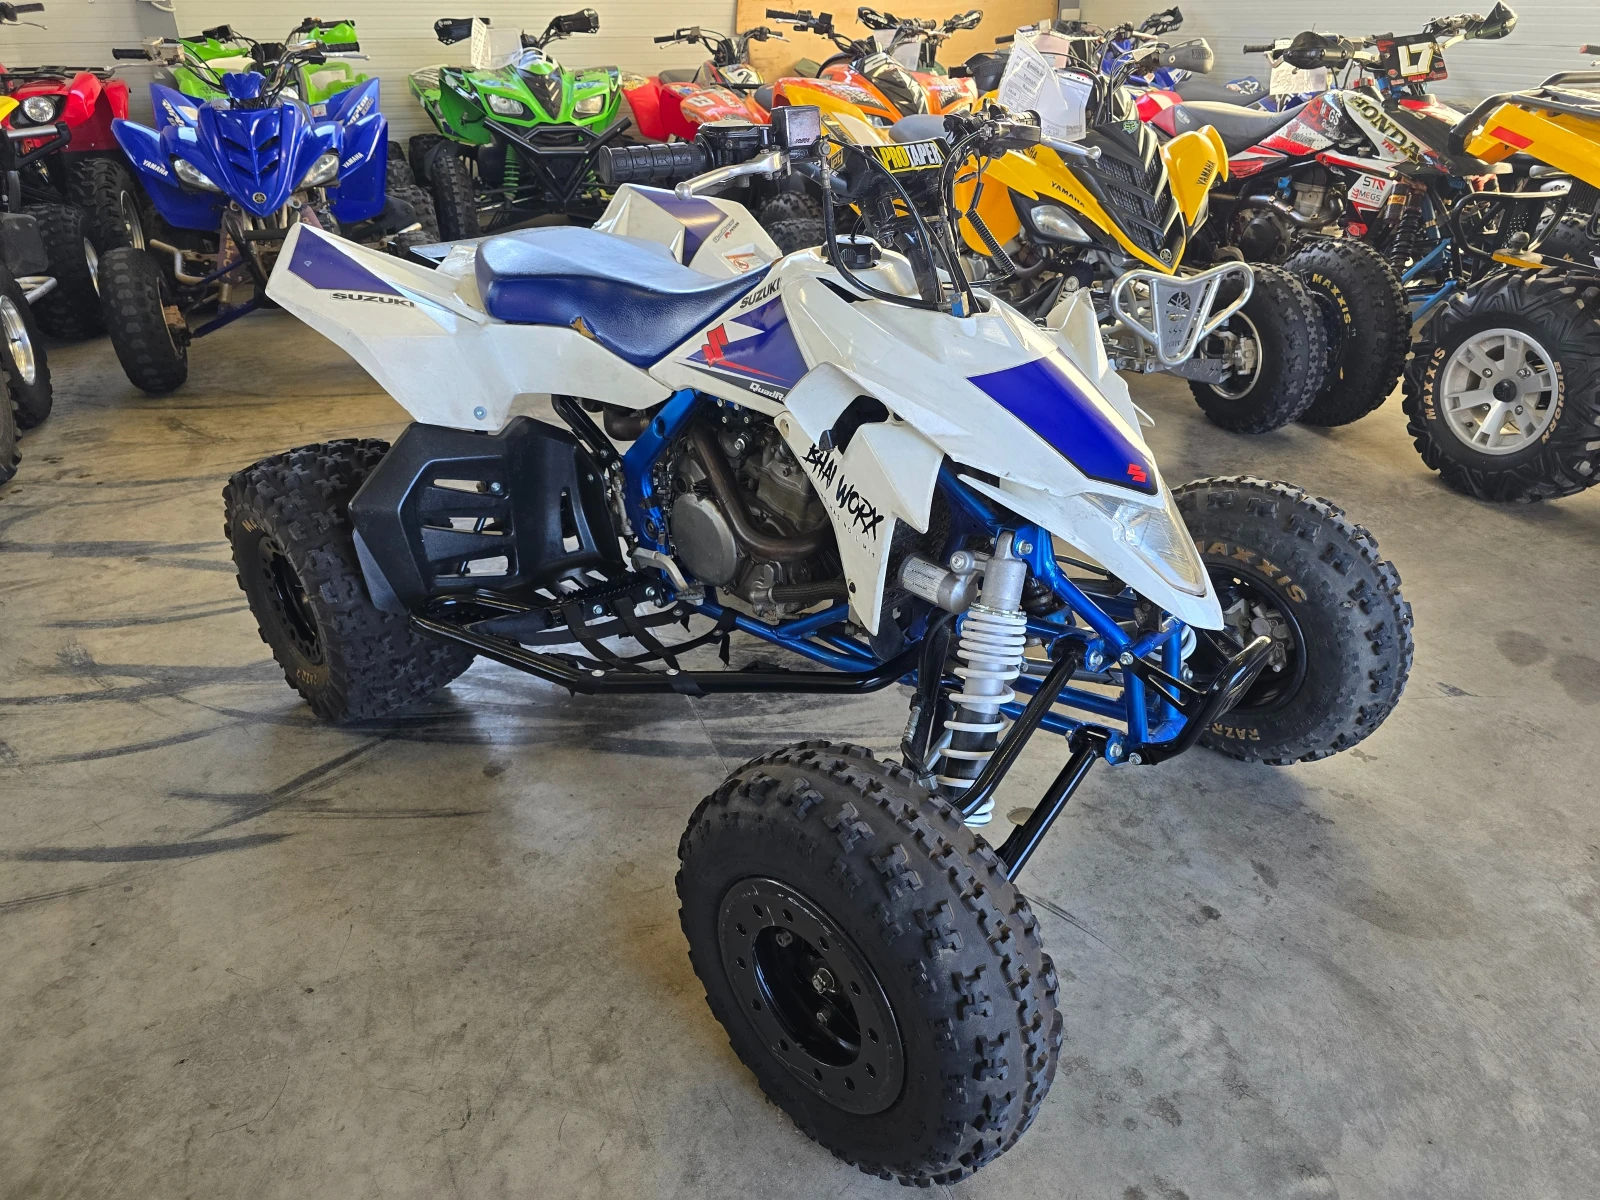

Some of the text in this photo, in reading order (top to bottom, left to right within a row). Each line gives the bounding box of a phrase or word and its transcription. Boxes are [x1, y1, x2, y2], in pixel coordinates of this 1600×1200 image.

[1350, 95, 1420, 164] HONDA
[1381, 139, 1398, 154] TRX
[142, 159, 169, 177] YAMAHA
[342, 152, 364, 169] YAMAHA
[1196, 160, 1217, 186] YAMAHA
[1051, 181, 1086, 208] YAMAHA
[1359, 190, 1382, 202] MEGS
[332, 292, 415, 308] SUZUKI
[740, 278, 780, 309] SUZUKI
[1312, 273, 1352, 324] MAXXIS
[1423, 347, 1446, 420] MAXXIS
[1541, 361, 1566, 445] BIGHORN
[836, 474, 885, 543] WORX
